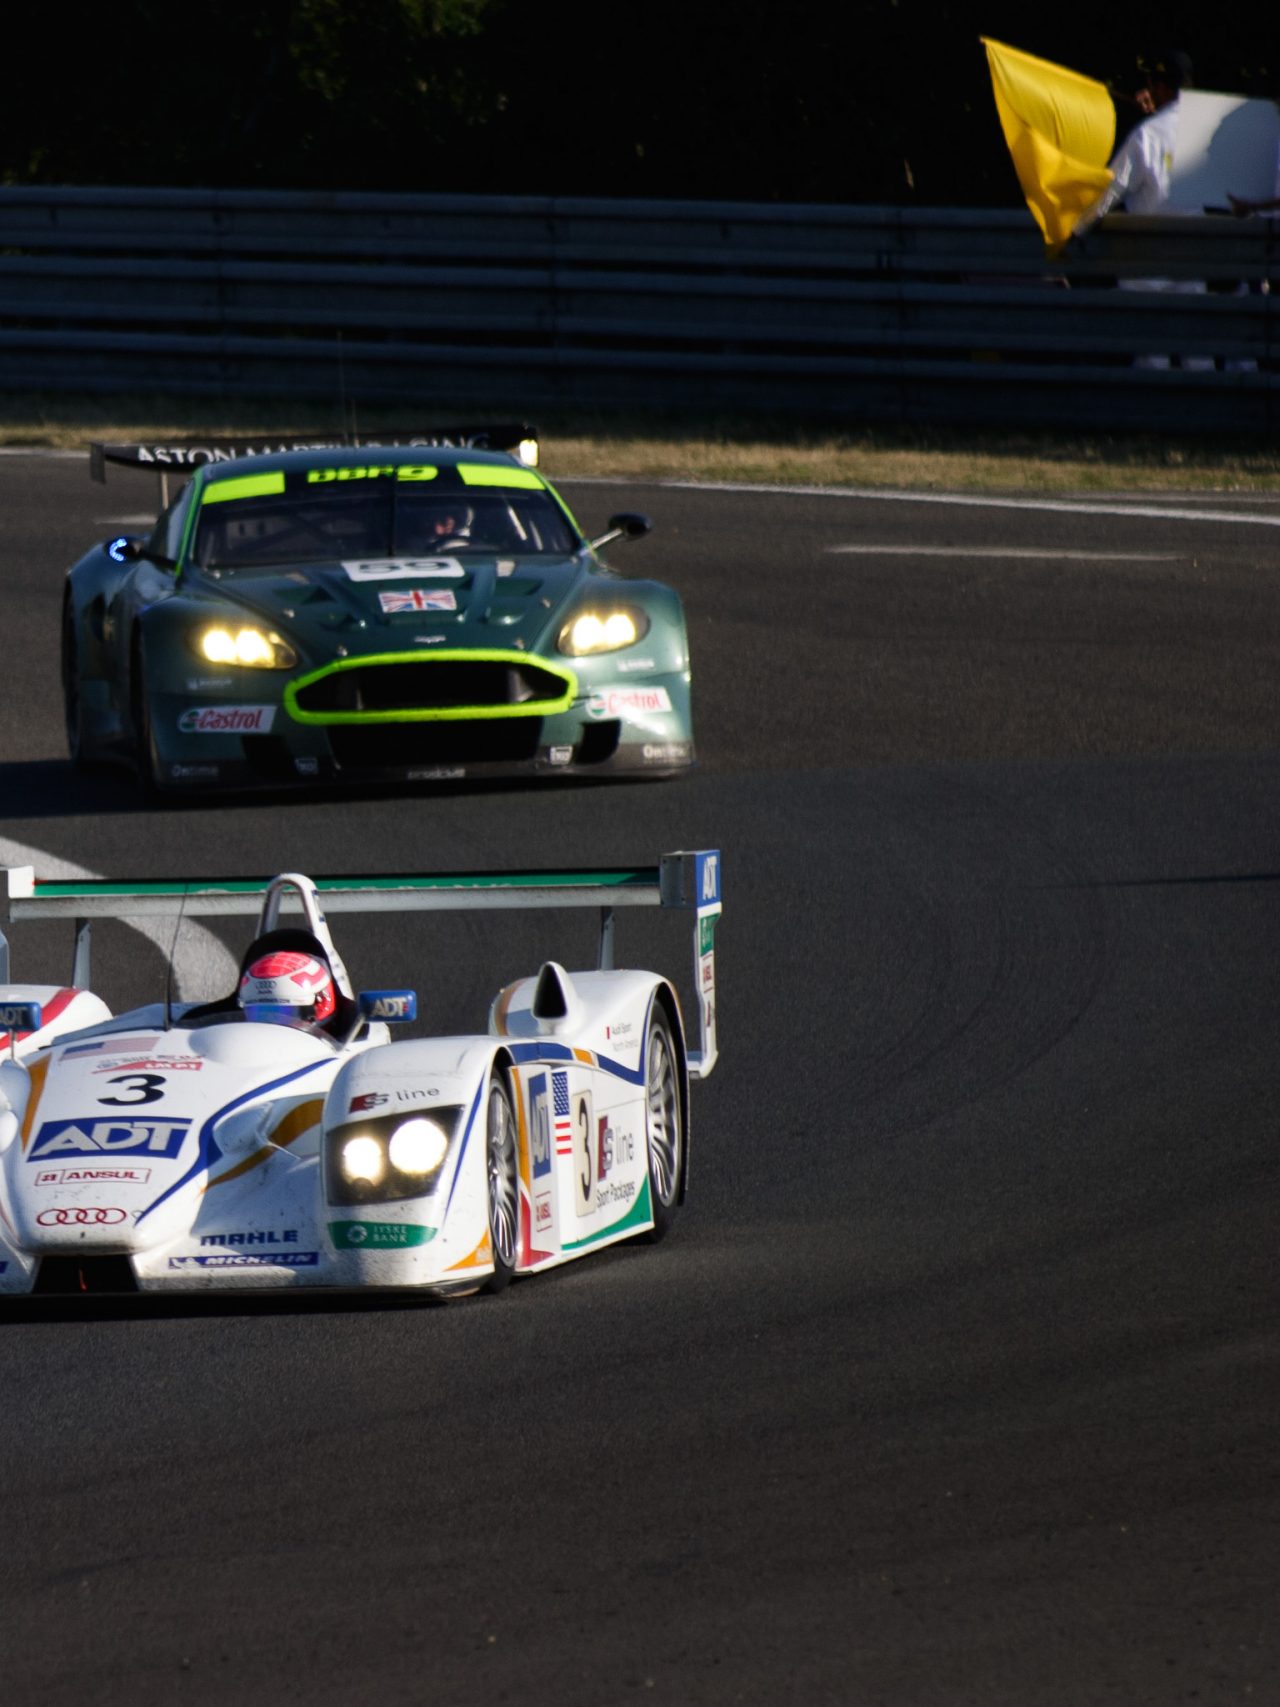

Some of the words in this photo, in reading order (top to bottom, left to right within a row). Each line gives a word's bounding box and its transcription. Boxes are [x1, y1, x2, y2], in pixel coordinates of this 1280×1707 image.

[198, 709, 263, 730] Castrol
[371, 997, 407, 1017] ADT
[96, 1073, 167, 1107] 3
[396, 1086, 441, 1102] line
[30, 1121, 192, 1157] ADT
[615, 1125, 635, 1166] line
[578, 1097, 592, 1203] 3
[66, 1170, 140, 1181] ANSUL
[200, 1229, 298, 1247] MAHLE
[373, 1233, 408, 1243] BANK
[203, 1252, 314, 1266] MICHELIN
